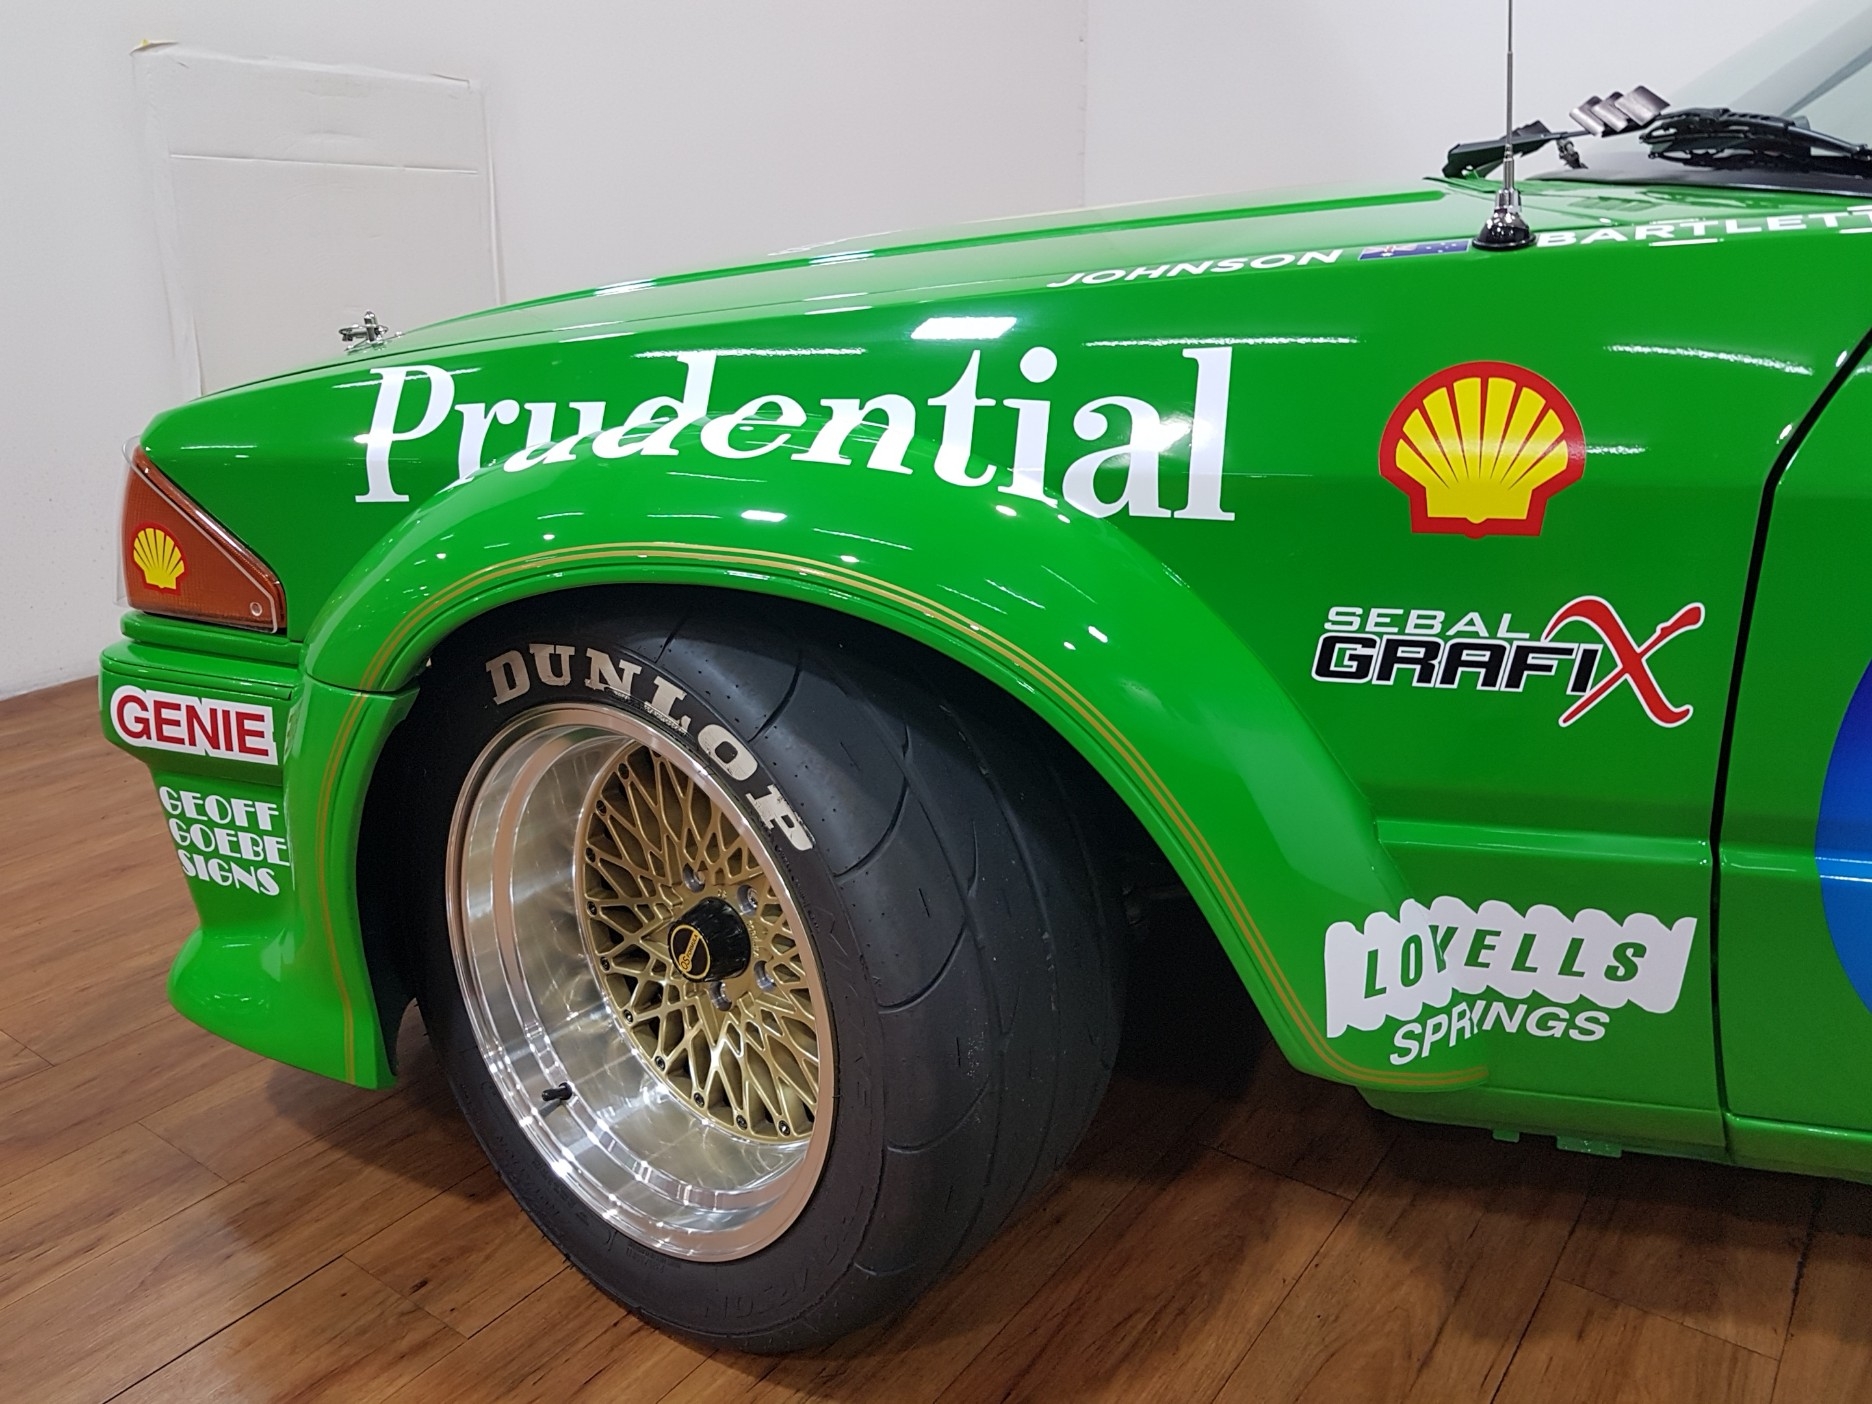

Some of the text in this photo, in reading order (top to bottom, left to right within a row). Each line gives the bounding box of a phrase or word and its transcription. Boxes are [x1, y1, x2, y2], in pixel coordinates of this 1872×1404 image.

[1536, 210, 1872, 248] BARTLET
[1046, 249, 1344, 287] JOHNSON
[354, 346, 1237, 521] Prudential
[1323, 605, 1531, 641] SEBAL
[1311, 595, 1705, 728] GRAFIX
[116, 694, 271, 757] GENIE
[484, 643, 816, 851] DUNLOP
[159, 786, 280, 831] GEOFF
[168, 817, 291, 867] GOEBE
[177, 849, 280, 897] SIGNS
[1390, 1000, 1611, 1066] SPRINGS
